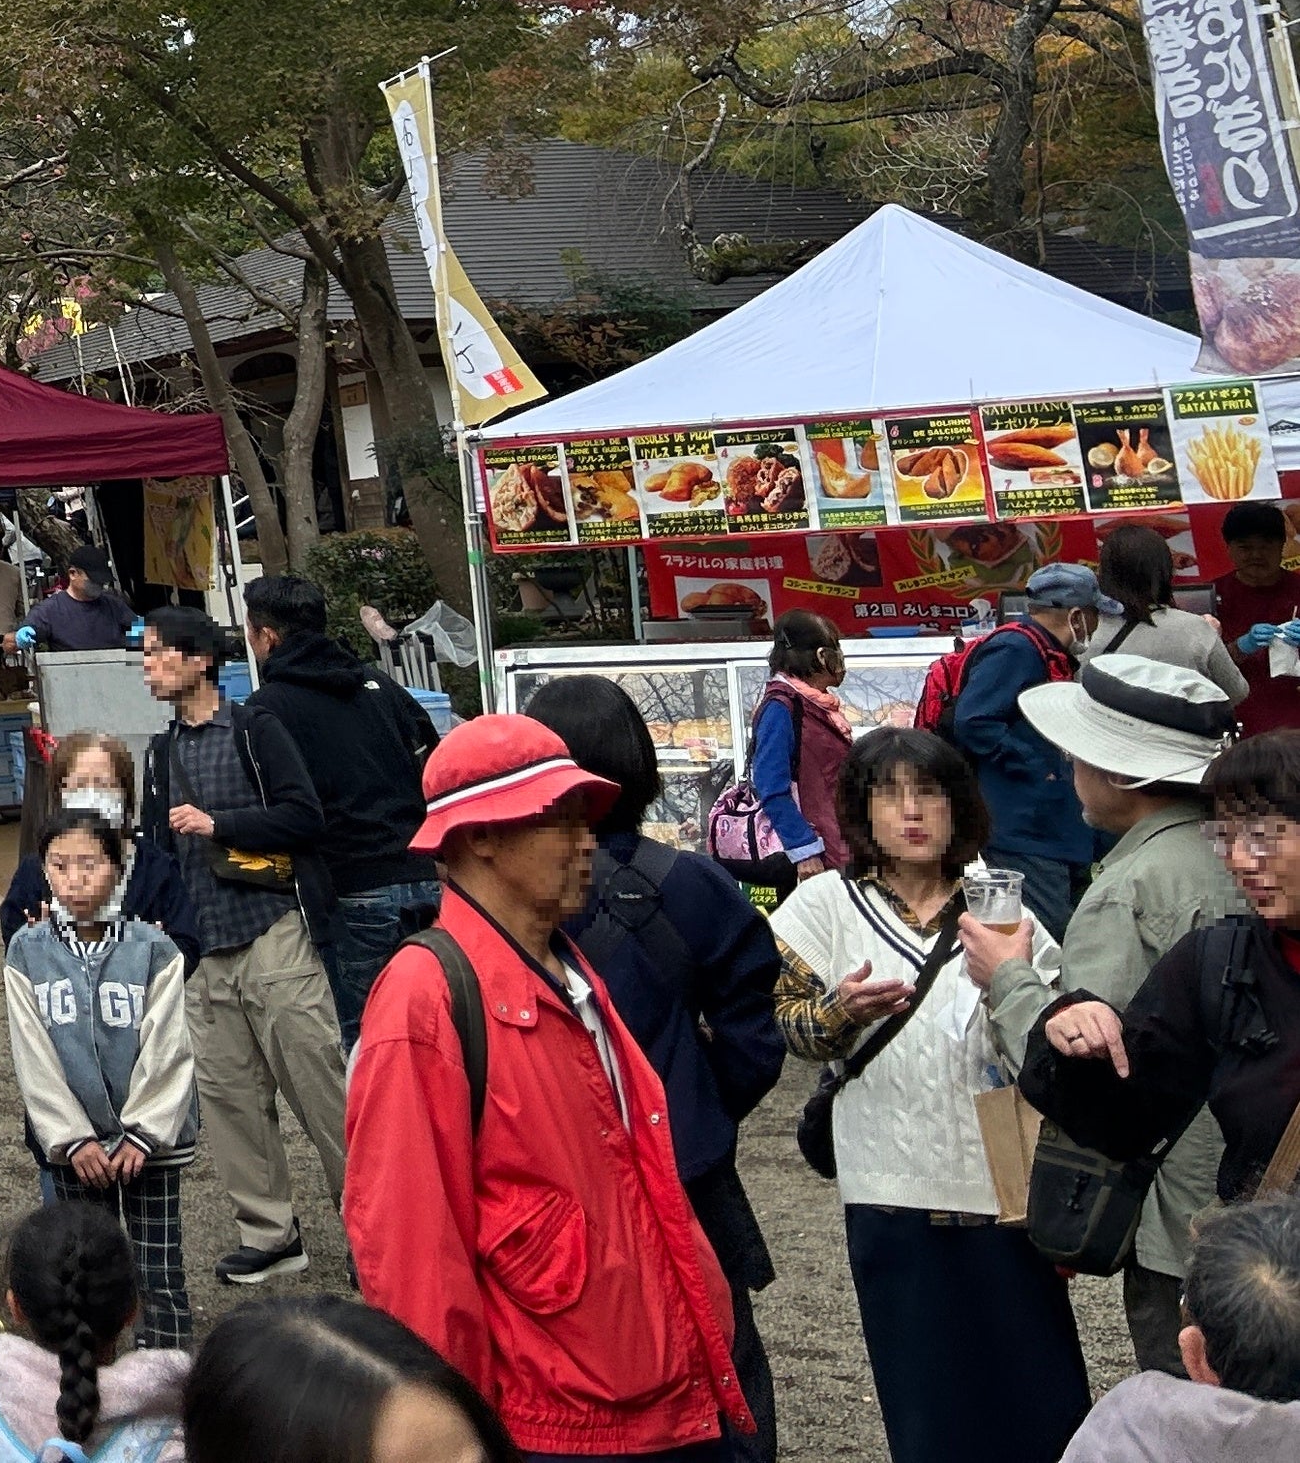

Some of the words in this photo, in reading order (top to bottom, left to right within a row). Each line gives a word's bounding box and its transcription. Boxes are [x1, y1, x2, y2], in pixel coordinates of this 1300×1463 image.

[1174, 386, 1253, 403] フライドポテト
[981, 401, 1071, 416] NAPOLITANO
[1179, 401, 1219, 414] BATATA
[1222, 398, 1253, 411] FRITA
[991, 416, 1064, 431] ナポリターノ
[726, 432, 787, 444] みしまコロッケ
[660, 554, 784, 571] ブラジルの家庭料理
[853, 602, 898, 618] 第2回
[903, 603, 997, 619] みしまコロケ
